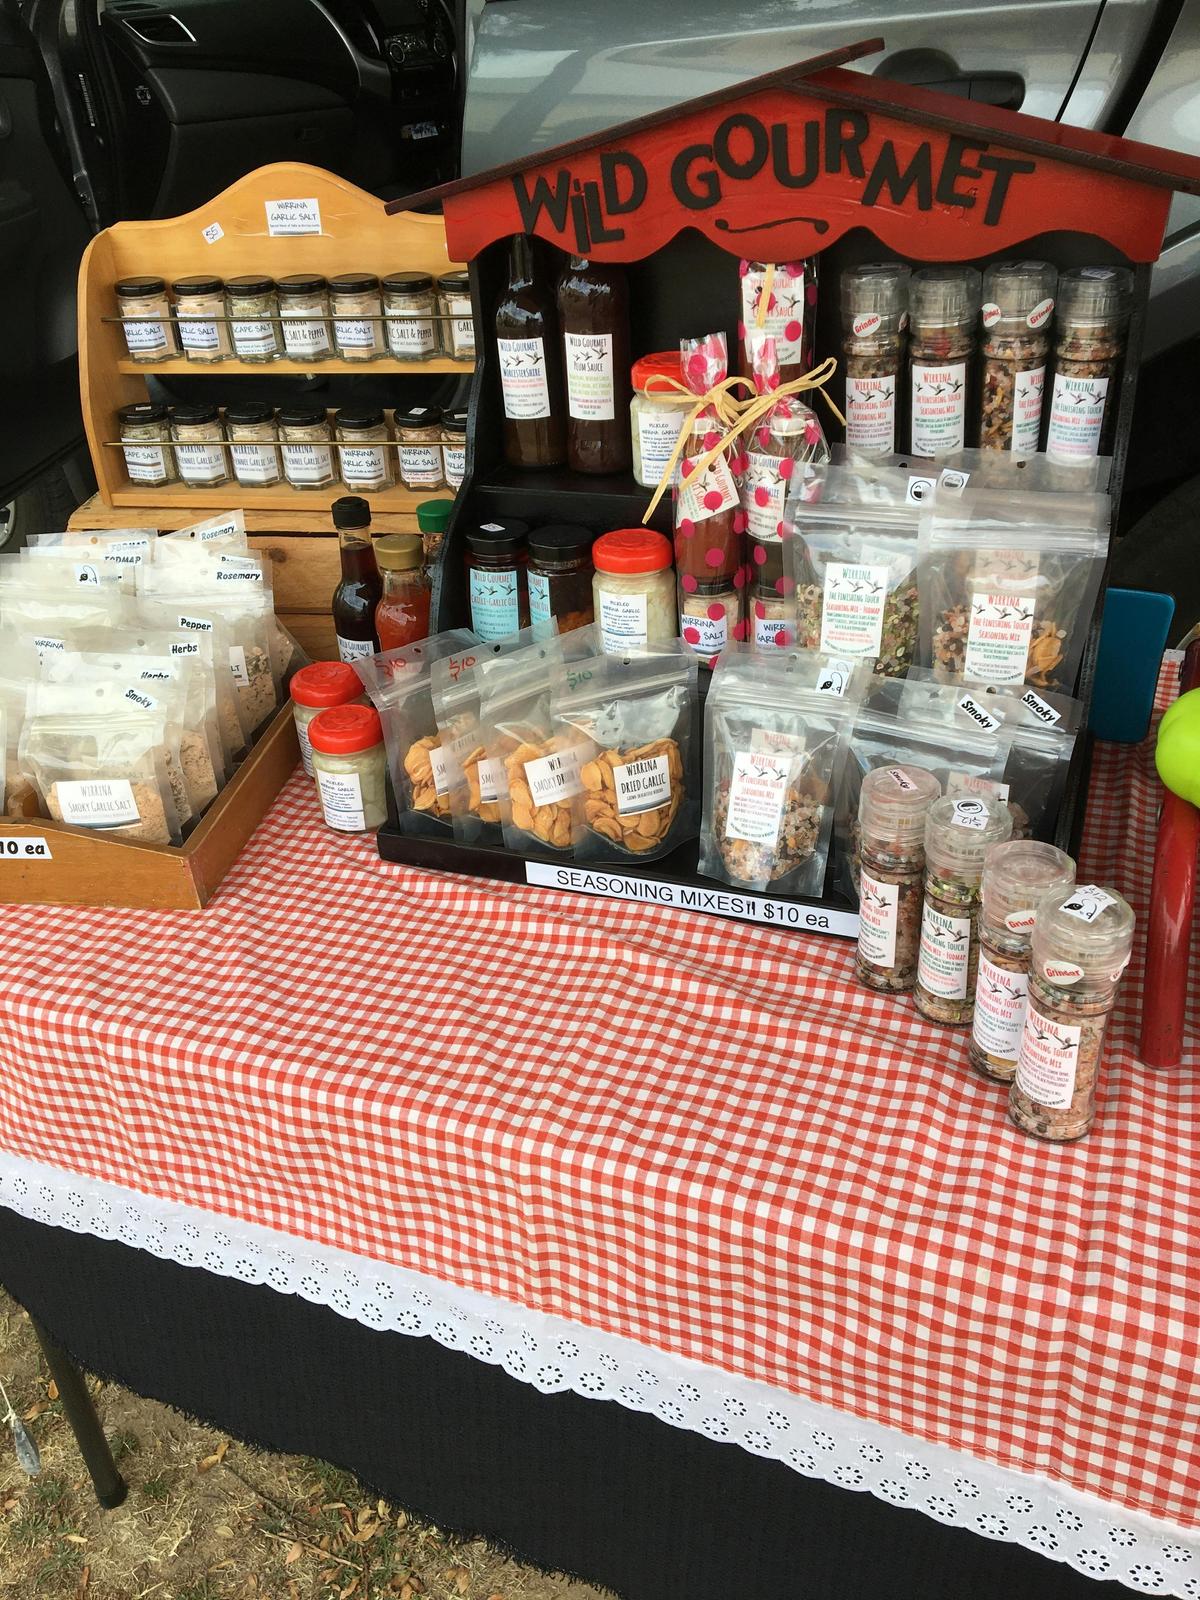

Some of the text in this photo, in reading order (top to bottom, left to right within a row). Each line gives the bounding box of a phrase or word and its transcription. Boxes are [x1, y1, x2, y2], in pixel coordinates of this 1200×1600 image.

[671, 107, 1036, 227] GOURMET
[144, 325, 161, 335] SALT
[197, 326, 216, 335] SALT
[254, 322, 272, 332] SALT
[354, 325, 371, 335] SALT
[854, 315, 880, 334] Grinder
[290, 329, 301, 340] SALT
[308, 327, 325, 340] PEPPER
[396, 328, 409, 340] SALT
[416, 327, 432, 340] PEPPER
[512, 341, 538, 352] GOURMET
[582, 338, 607, 348] GOURMET
[587, 362, 603, 372] SAUCE
[142, 451, 159, 459] SALT
[422, 457, 440, 465] SALT
[366, 458, 382, 467] SALT
[201, 524, 236, 541] Rosemary
[216, 571, 261, 581] Rosemary
[487, 573, 513, 583] GOURMET
[180, 618, 212, 631] Pepper
[982, 617, 1011, 630] FINISHING
[703, 630, 725, 640] SALT
[978, 629, 1021, 642] SEASONING MIX
[171, 644, 198, 654] Herbs
[449, 655, 477, 681] $10
[567, 670, 593, 690] $10
[125, 689, 153, 709] Smoky
[1022, 693, 1056, 723] Smoky
[961, 700, 994, 729] Smoky
[625, 759, 658, 777] WIRRINA
[533, 777, 556, 794] SMOKY
[620, 773, 666, 794] DRIED GARLIC
[68, 800, 132, 813] SMOKY GARLIC SALT
[25, 845, 45, 855] ea
[556, 869, 831, 929] SEASONING MIXES $10 ea
[1082, 886, 1108, 903] $12
[1008, 916, 1035, 929] Grind
[947, 941, 965, 951] TOUCH
[946, 950, 966, 961] FODMAP
[1045, 967, 1080, 978] Grinder
[1003, 998, 1023, 1009] TOUCH
[1000, 1009, 1013, 1019] MIX
[1028, 1009, 1060, 1037] WIRRINA
[1053, 1047, 1073, 1059] TOUCH
[1049, 1057, 1063, 1069] MIX
